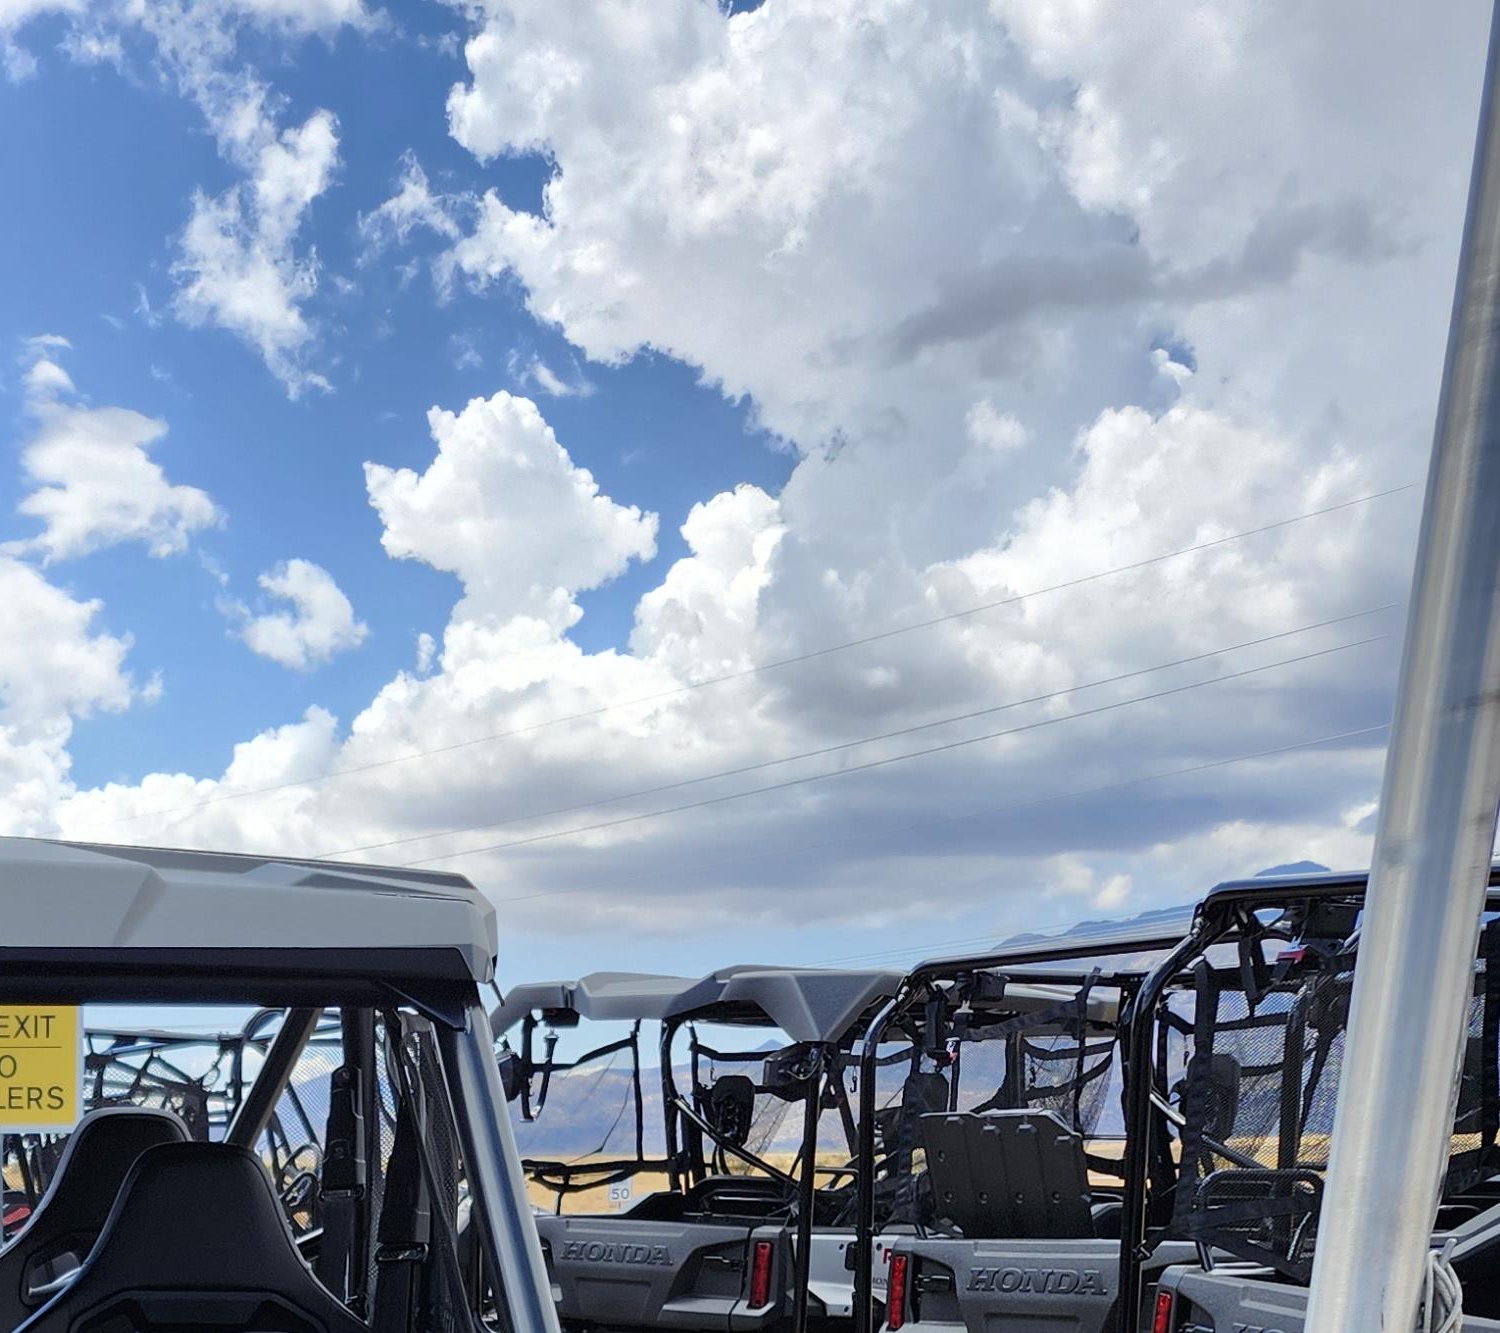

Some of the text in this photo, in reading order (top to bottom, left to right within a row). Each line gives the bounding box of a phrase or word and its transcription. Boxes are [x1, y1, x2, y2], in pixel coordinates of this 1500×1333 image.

[611, 1188, 629, 1200] 50
[560, 1240, 674, 1266] HONDA
[966, 1267, 1108, 1296] HONDA
